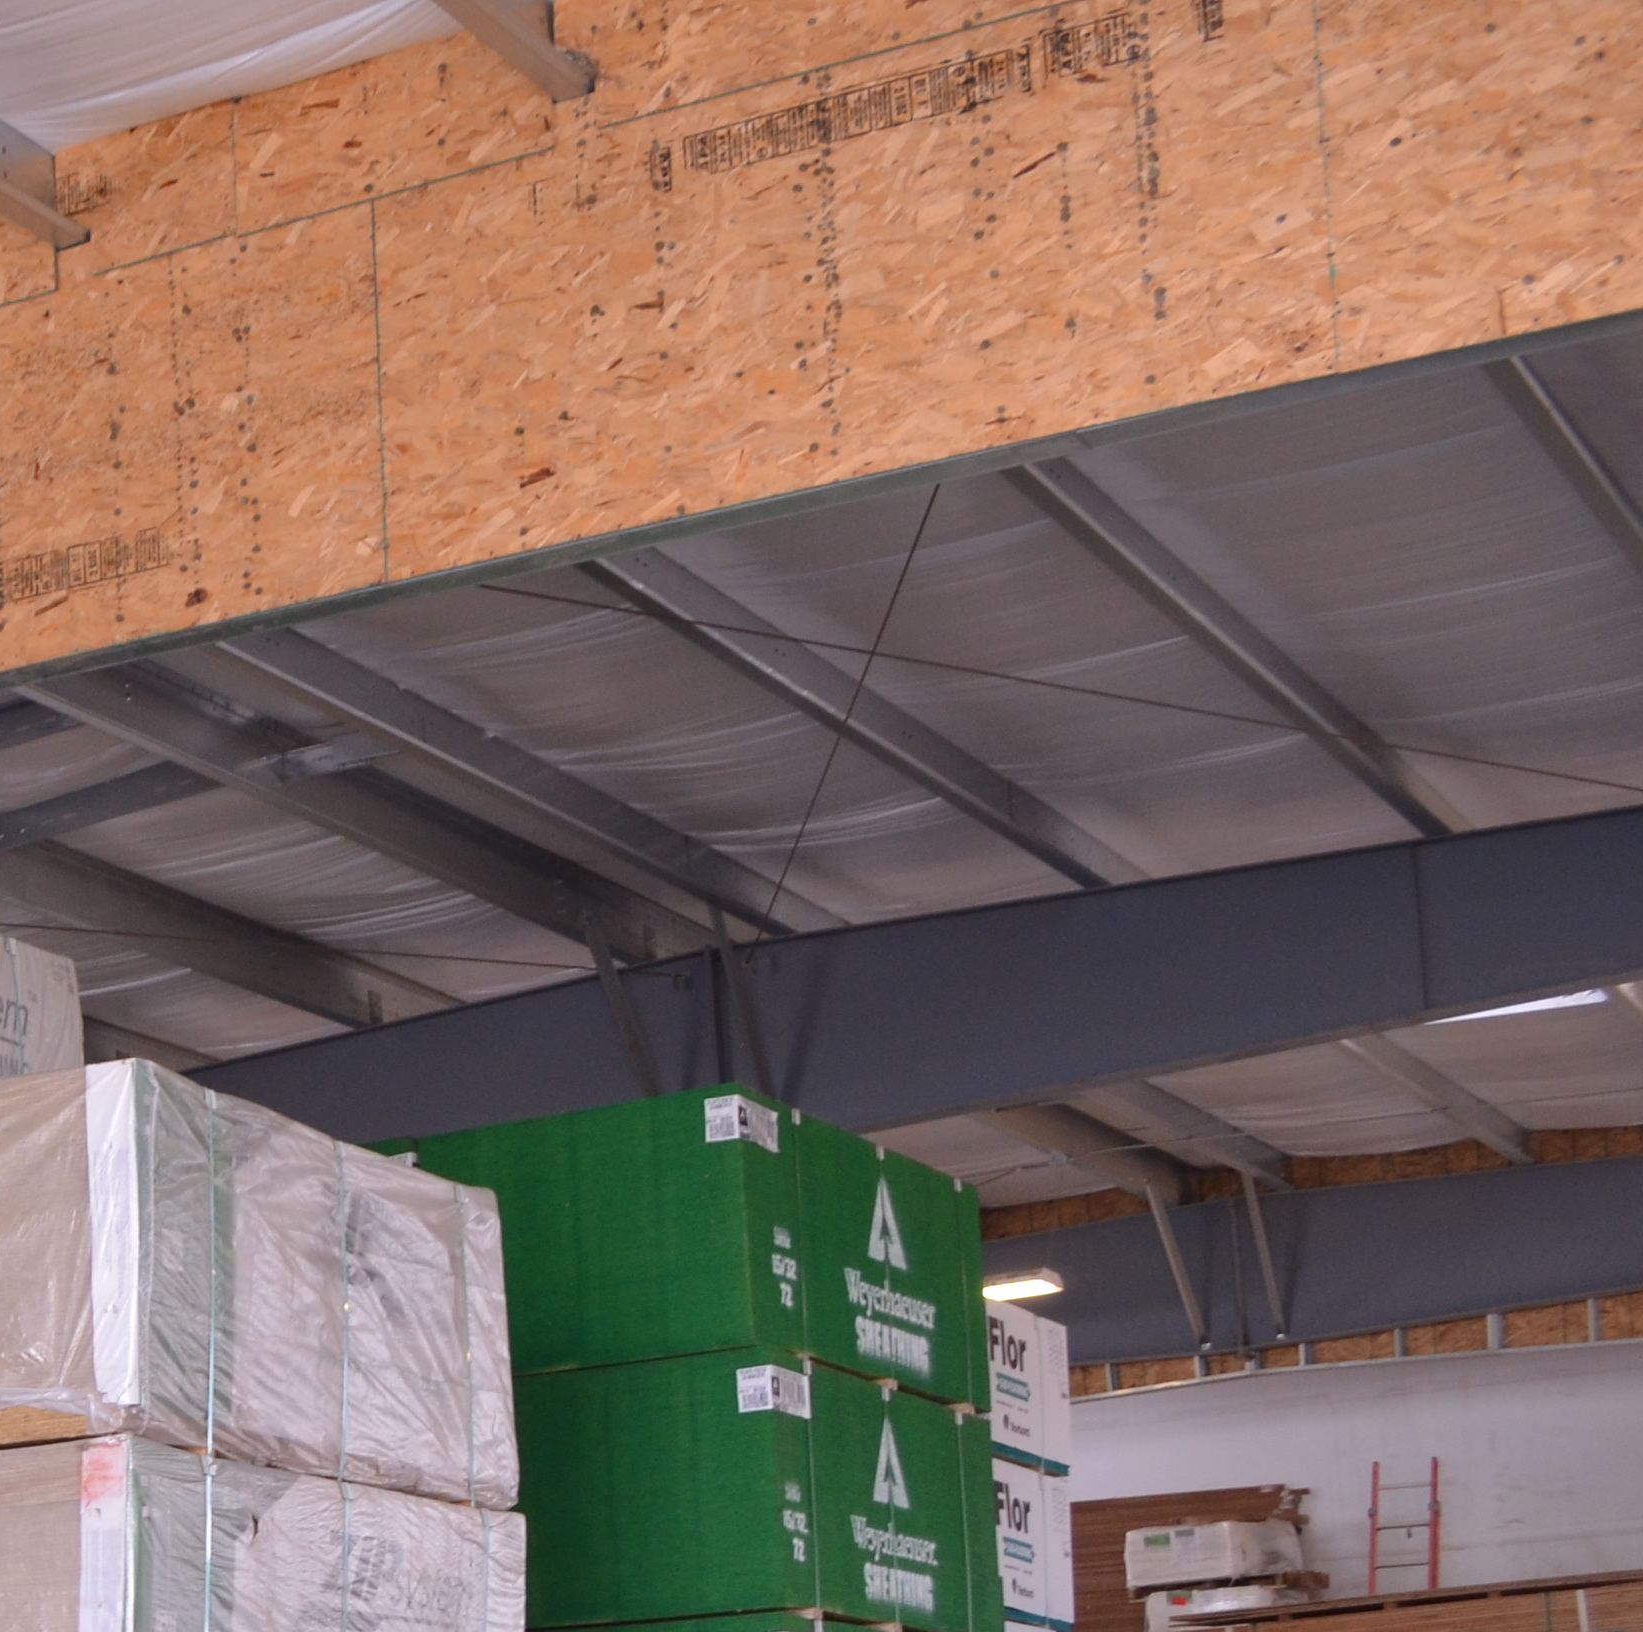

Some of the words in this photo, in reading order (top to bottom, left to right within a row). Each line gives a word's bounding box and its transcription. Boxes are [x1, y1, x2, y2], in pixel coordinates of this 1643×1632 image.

[844, 1267, 936, 1329] Weyerhaeuser
[988, 1316, 1026, 1372] Flor
[994, 1480, 1030, 1533] Flor
[850, 1514, 938, 1565] Weyerhaeuser
